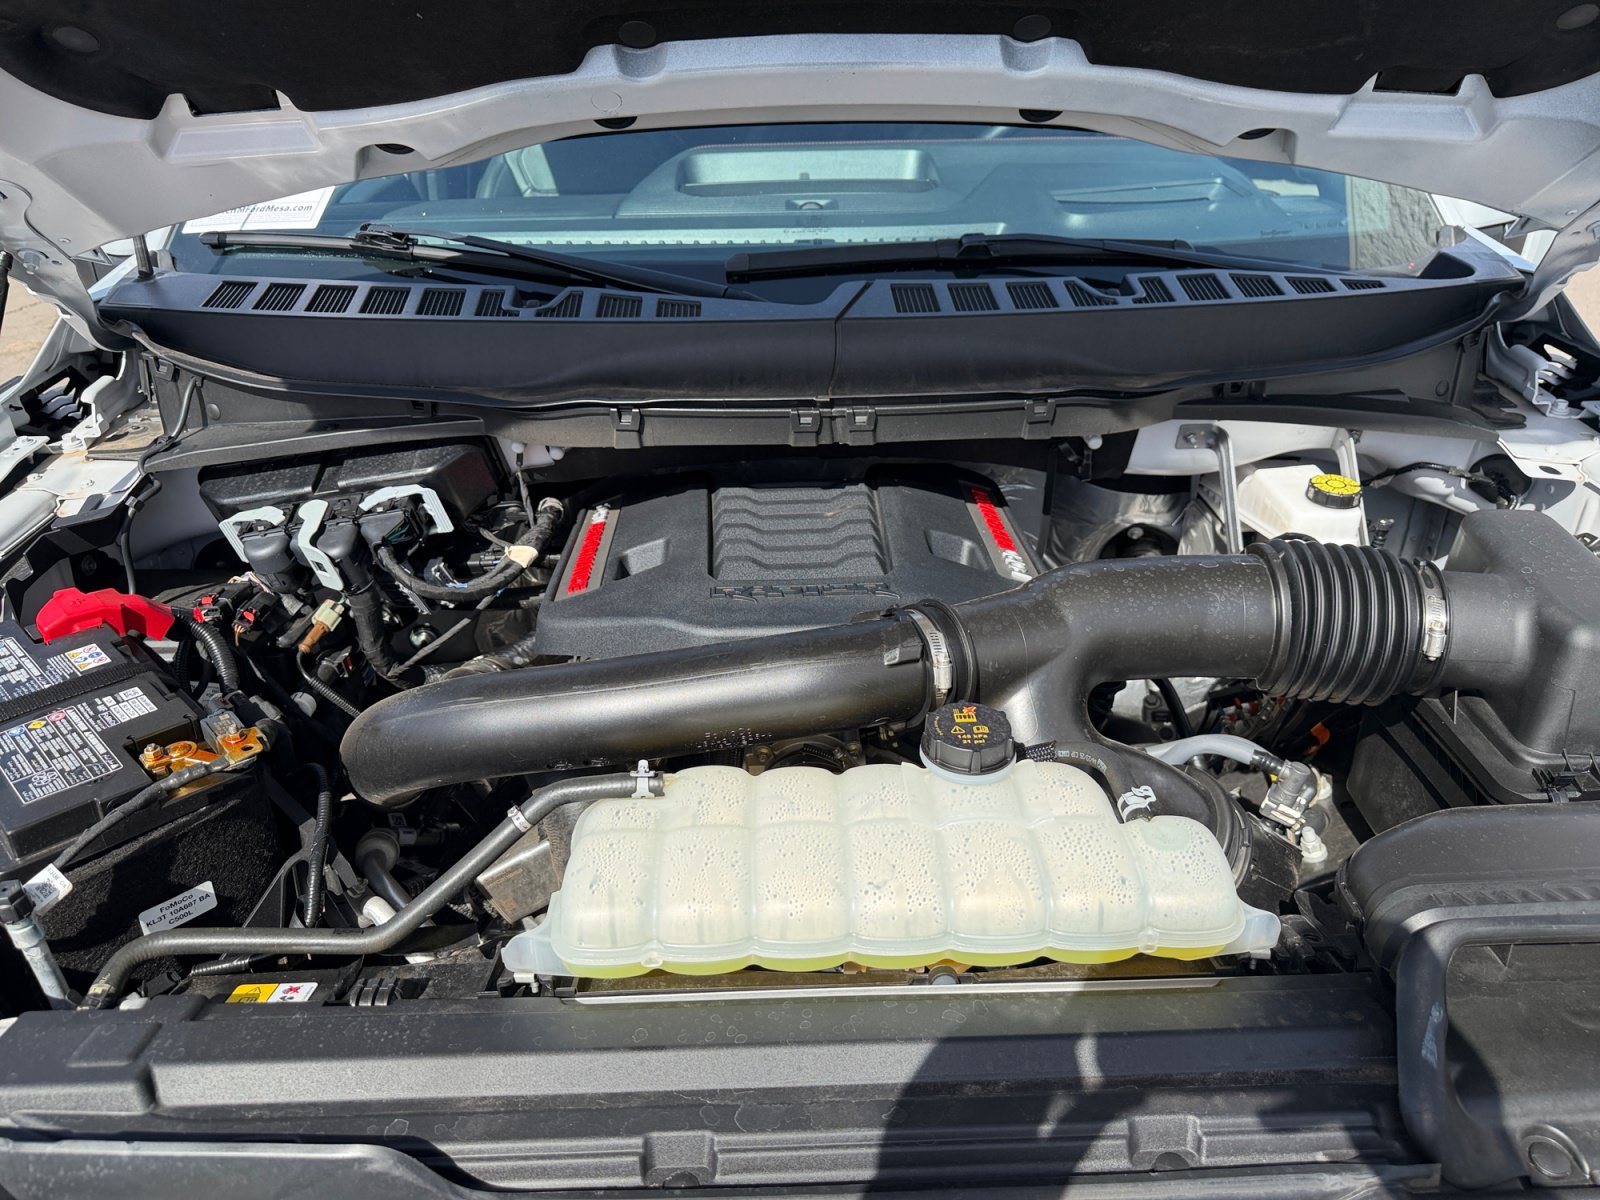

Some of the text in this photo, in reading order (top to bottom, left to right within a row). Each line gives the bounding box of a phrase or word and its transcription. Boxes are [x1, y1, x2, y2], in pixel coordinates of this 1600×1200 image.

[146, 893, 211, 928] KL3T 10A687 BA
[159, 894, 194, 913] FoMoCo
[168, 910, 194, 925] C500L
